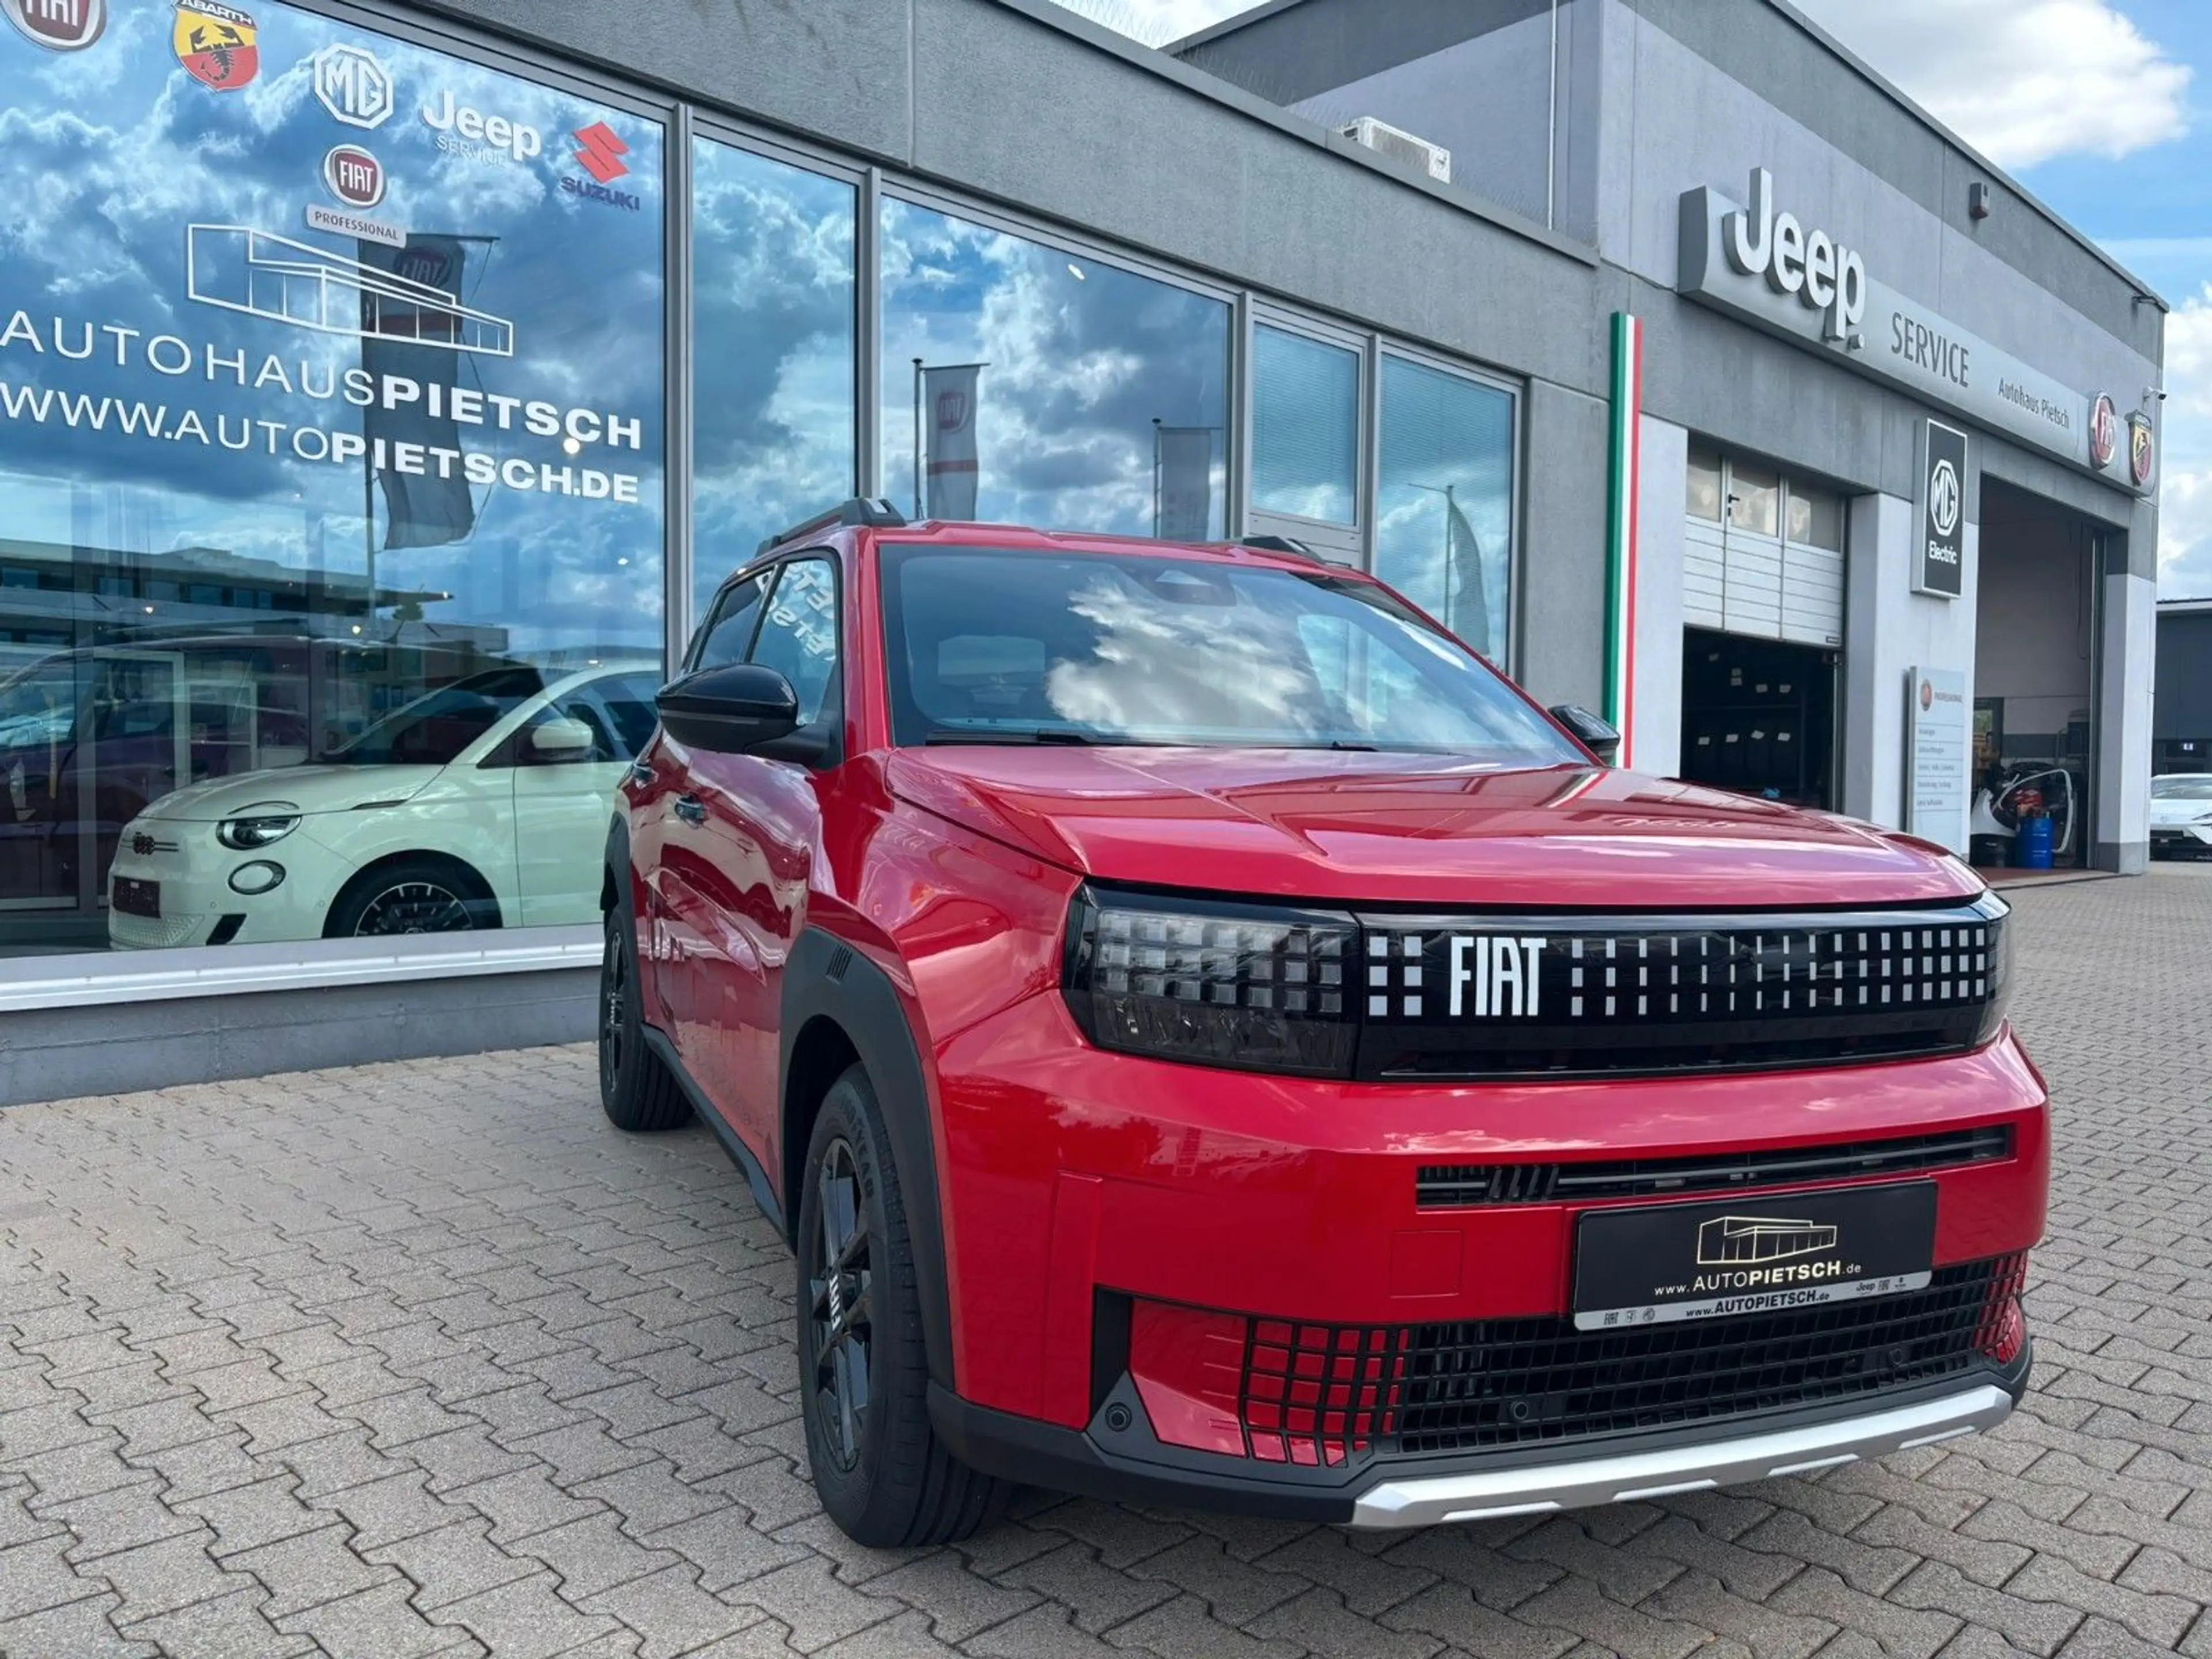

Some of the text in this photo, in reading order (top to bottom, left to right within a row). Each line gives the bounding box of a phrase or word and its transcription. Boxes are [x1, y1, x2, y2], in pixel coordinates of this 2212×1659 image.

[181, 0, 251, 24] ABARTH
[422, 88, 541, 161] Jeep
[435, 135, 507, 167] SERVICE
[339, 160, 374, 193] FIAT
[560, 176, 640, 211] SUZUKI
[314, 211, 399, 240] PROFESSIONAL
[1723, 166, 1866, 341] Jeep
[1892, 311, 1969, 388] SERVICE
[1998, 377, 2039, 415] Autohaus
[2041, 399, 2069, 429] Pietsch
[1929, 540, 1957, 565] Electric
[1449, 936, 1547, 1016] FIAT
[1685, 1290, 1830, 1317] www.AUTOPIETSCH.de
